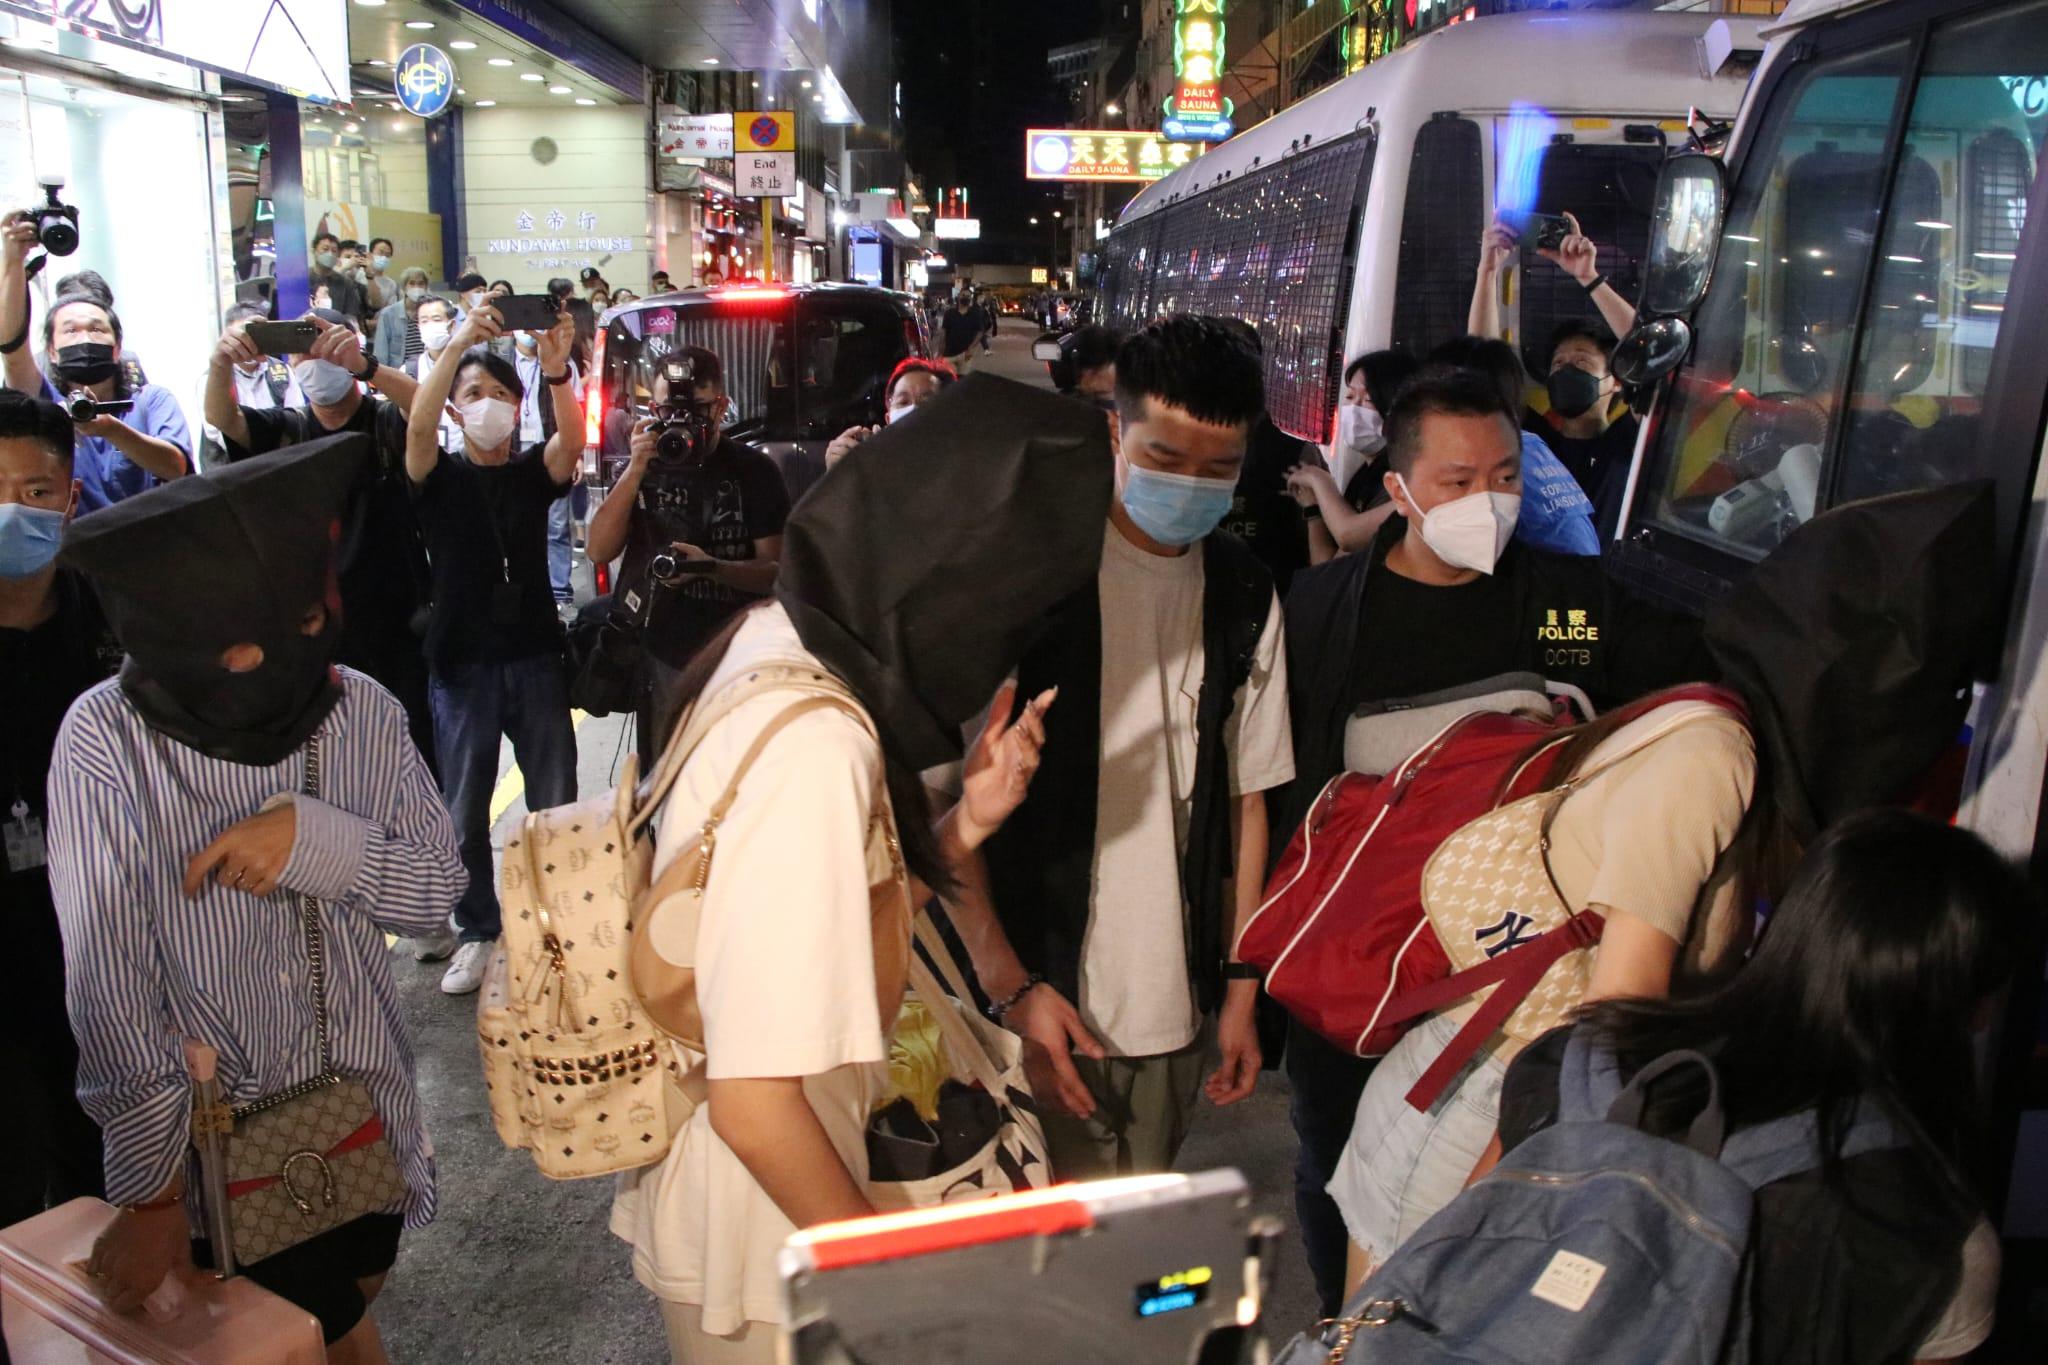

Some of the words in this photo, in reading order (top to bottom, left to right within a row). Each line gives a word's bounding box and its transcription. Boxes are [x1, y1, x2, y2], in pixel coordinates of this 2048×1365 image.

[1183, 88, 1215, 98] DAILY
[1180, 100, 1218, 110] SAUNA
[675, 137, 729, 150] 金帝行
[754, 159, 776, 169] End
[1068, 166, 1095, 175] DAILY
[1098, 166, 1129, 175] SAUNA
[750, 175, 782, 189] 終止
[517, 210, 597, 232] 金帝行
[488, 239, 573, 253] KUNDAMAL
[577, 238, 633, 251] HOUSE
[1537, 626, 1599, 641] POLICE
[1545, 648, 1591, 666] OCTB
